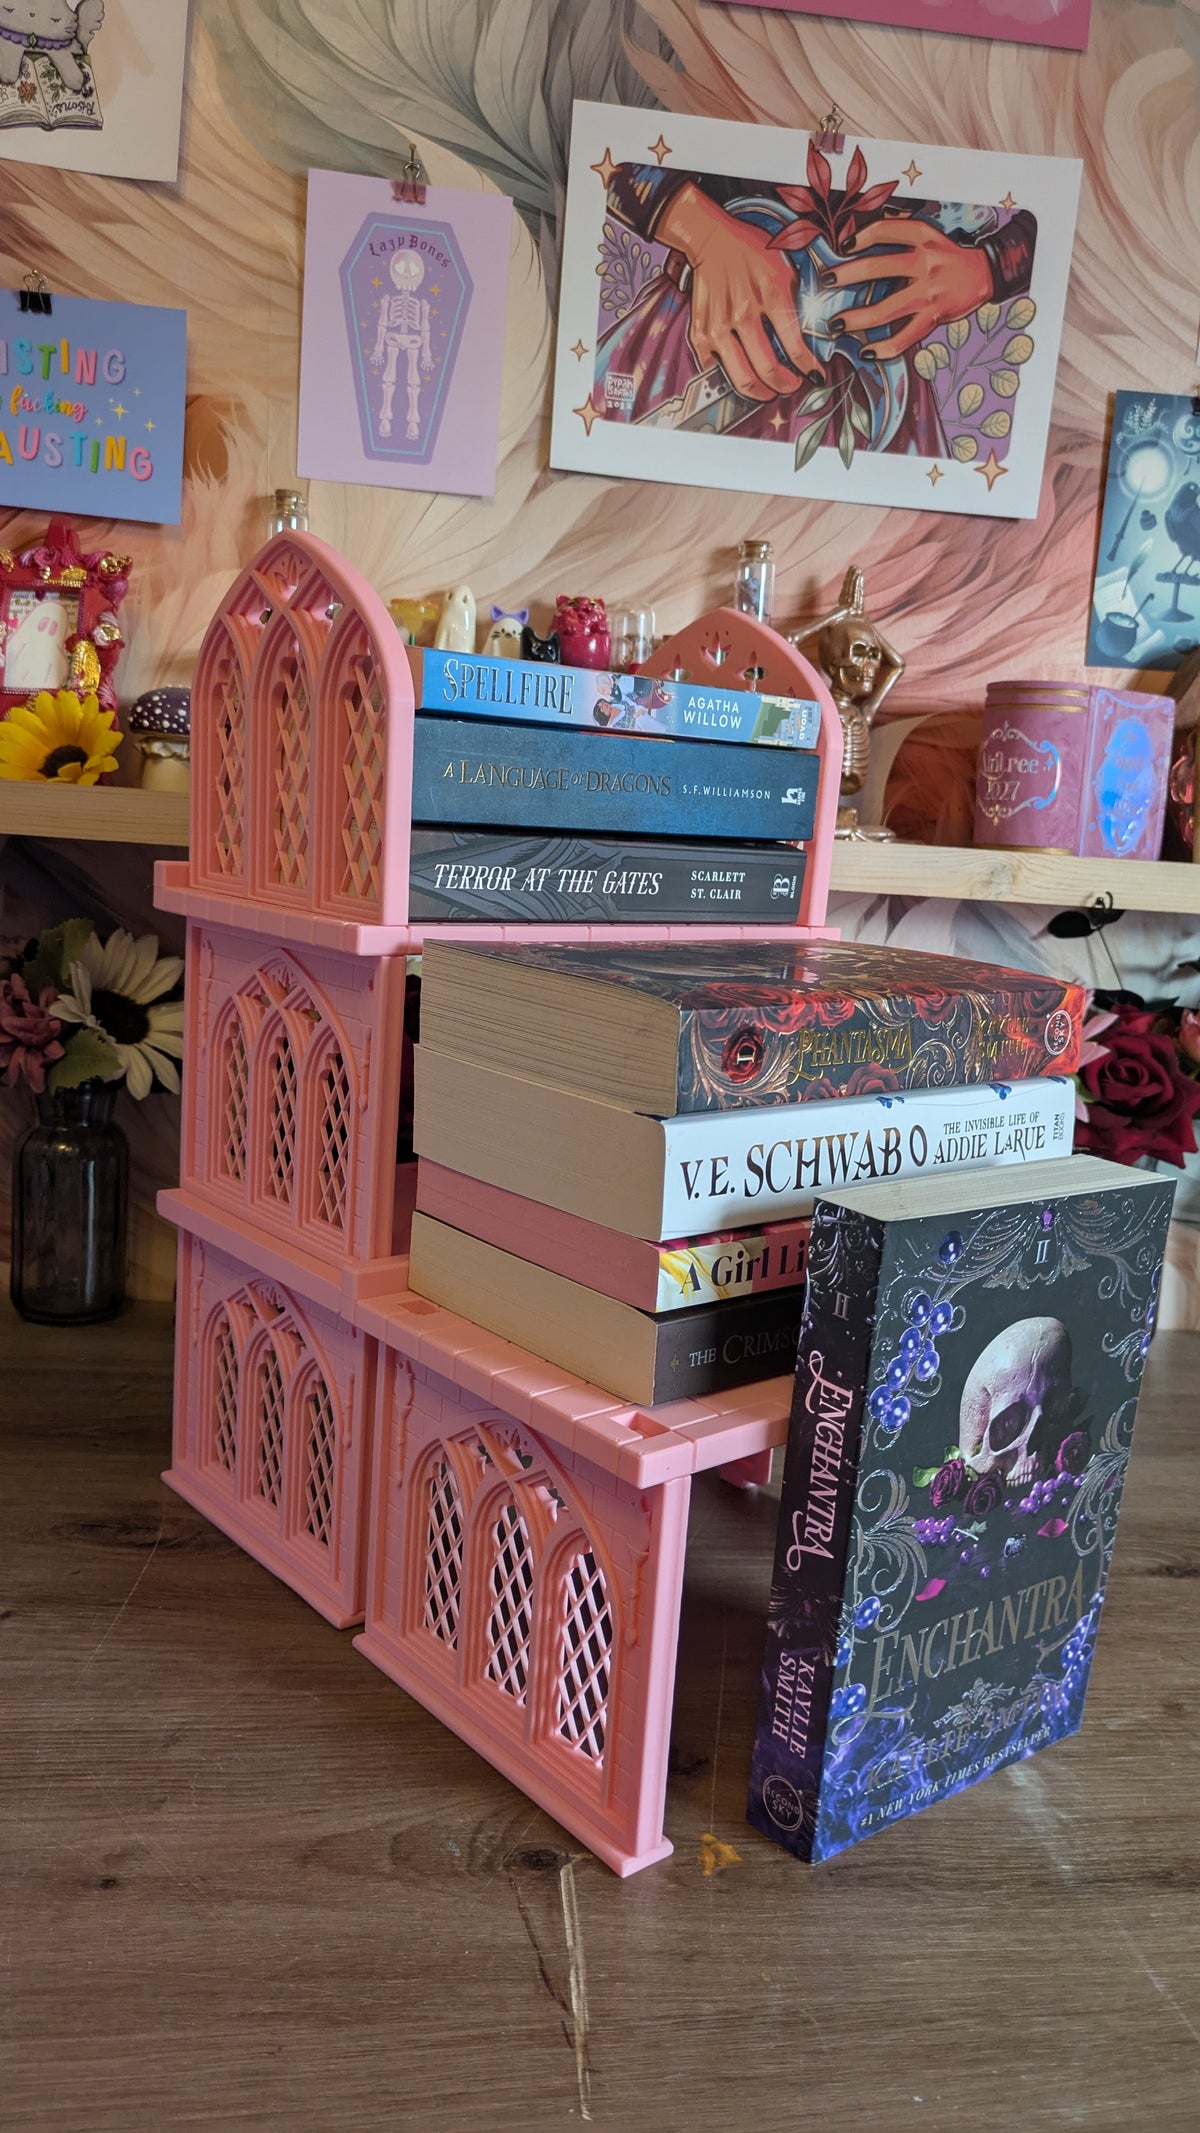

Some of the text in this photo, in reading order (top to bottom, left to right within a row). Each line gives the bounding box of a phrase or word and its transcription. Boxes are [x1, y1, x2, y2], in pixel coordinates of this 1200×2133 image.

[369, 234, 451, 268] Lazy Bones
[10, 384, 88, 423] fucking
[443, 658, 576, 715] SPELLFIRE
[683, 710, 743, 729] WILLOW
[688, 696, 740, 713] AGATHA
[799, 709, 808, 741] avon
[443, 761, 454, 778] A
[459, 760, 569, 791] LANGUAGE
[584, 769, 671, 797] DRAGONS
[434, 864, 663, 895] TERROR AT THE GATES
[690, 871, 746, 883] SCARLETT
[690, 888, 742, 900] ST. CLAIR
[1053, 1014, 1061, 1051] SECOND
[786, 1024, 912, 1086] PHANTASMA
[944, 1111, 1040, 1135] THE INVISIBLE LIFE OF
[744, 1127, 902, 1198] SCHWAB
[932, 1133, 987, 1165] ADDIE
[1034, 1239, 1051, 1265] II
[679, 1262, 702, 1294] A
[711, 1245, 770, 1287] Girl
[689, 1348, 717, 1368] THE
[786, 1350, 853, 1571] ENCHANTRA
[831, 1559, 1084, 1746] ENCHANTRA
[771, 1651, 797, 1743] SMITH
[790, 1656, 815, 1759] KAYLIE
[766, 1786, 800, 1814] SECOND
[772, 1799, 792, 1820] SKY
[860, 1813, 873, 1827] #1
[876, 1798, 905, 1820] NEW
[908, 1781, 940, 1805] YORK
[944, 1760, 981, 1788] TIMES
